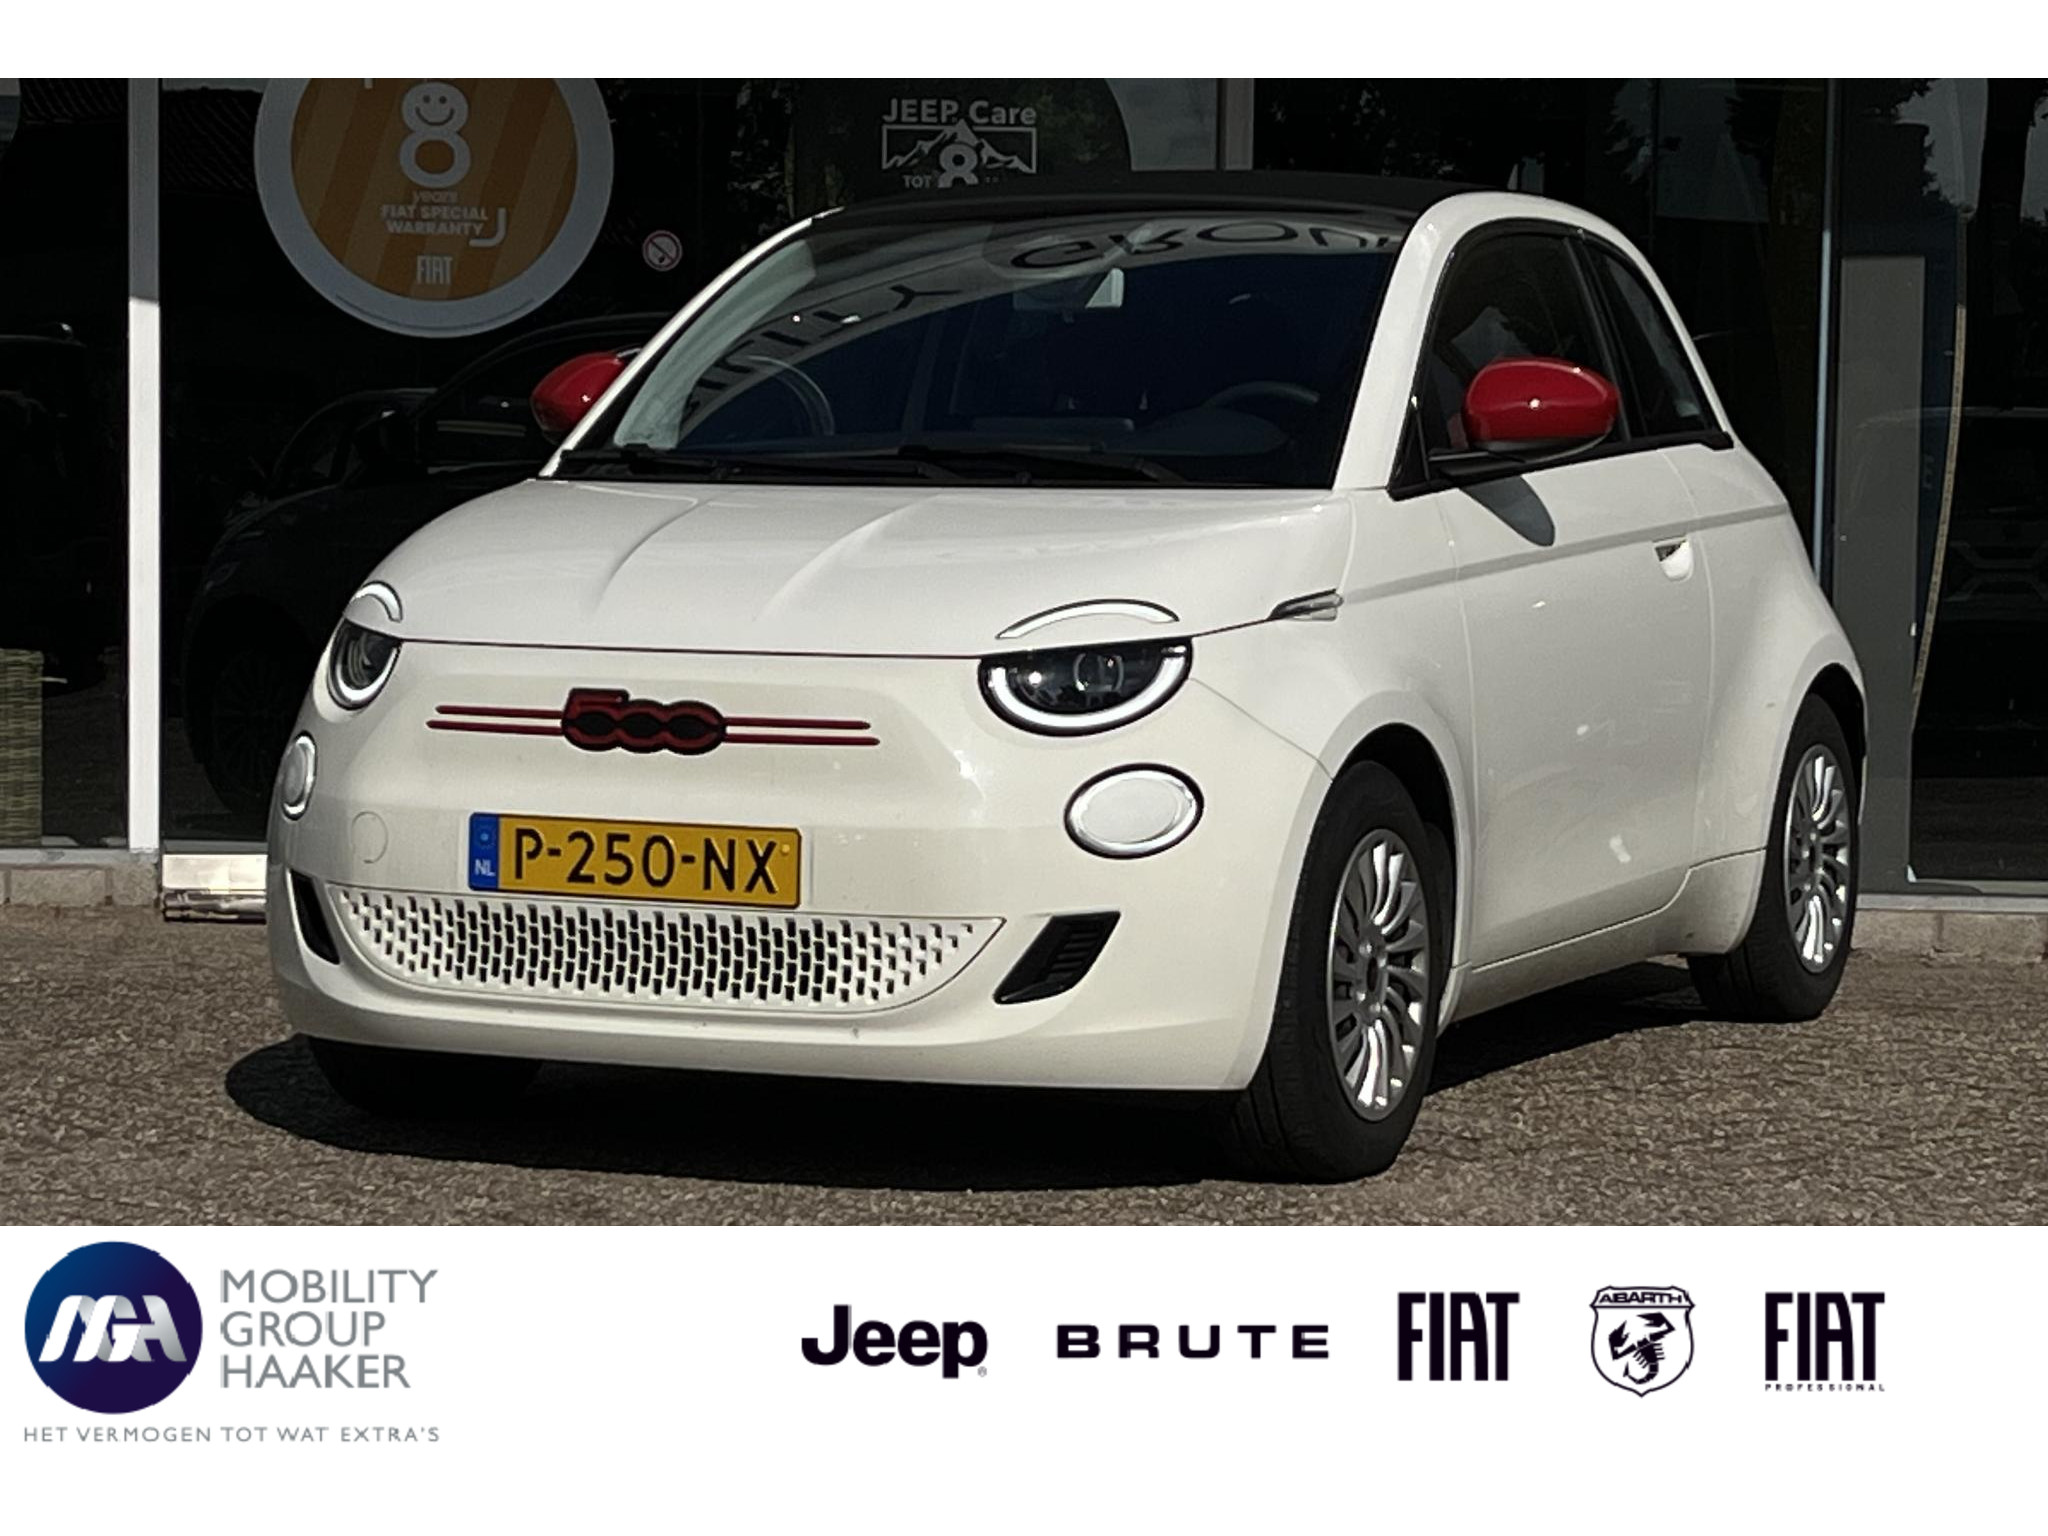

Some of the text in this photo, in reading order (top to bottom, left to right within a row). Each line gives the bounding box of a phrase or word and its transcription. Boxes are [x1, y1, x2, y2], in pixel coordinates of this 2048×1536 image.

[881, 97, 1038, 125] JEEP Care
[903, 174, 932, 189] TOT
[382, 205, 489, 221] FIAT SPECIAL
[386, 219, 486, 236] WARRANTY
[416, 256, 453, 285] FIAT
[474, 828, 778, 895] NL P-250-NX
